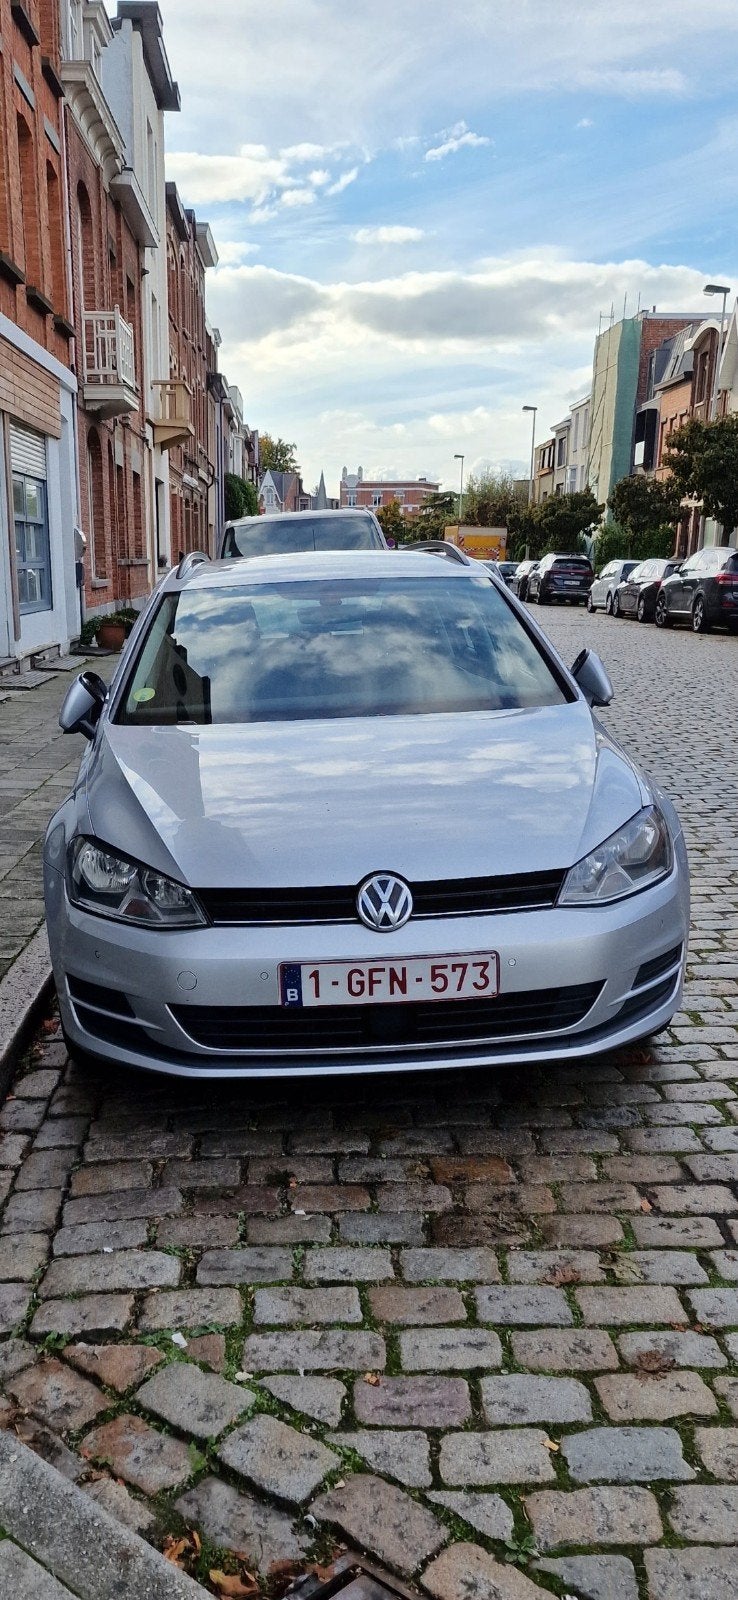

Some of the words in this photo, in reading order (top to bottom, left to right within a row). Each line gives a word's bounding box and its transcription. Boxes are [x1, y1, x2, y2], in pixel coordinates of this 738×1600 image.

[358, 875, 413, 930] VW
[286, 988, 299, 1002] B
[308, 961, 490, 998] 1-GFN-573
